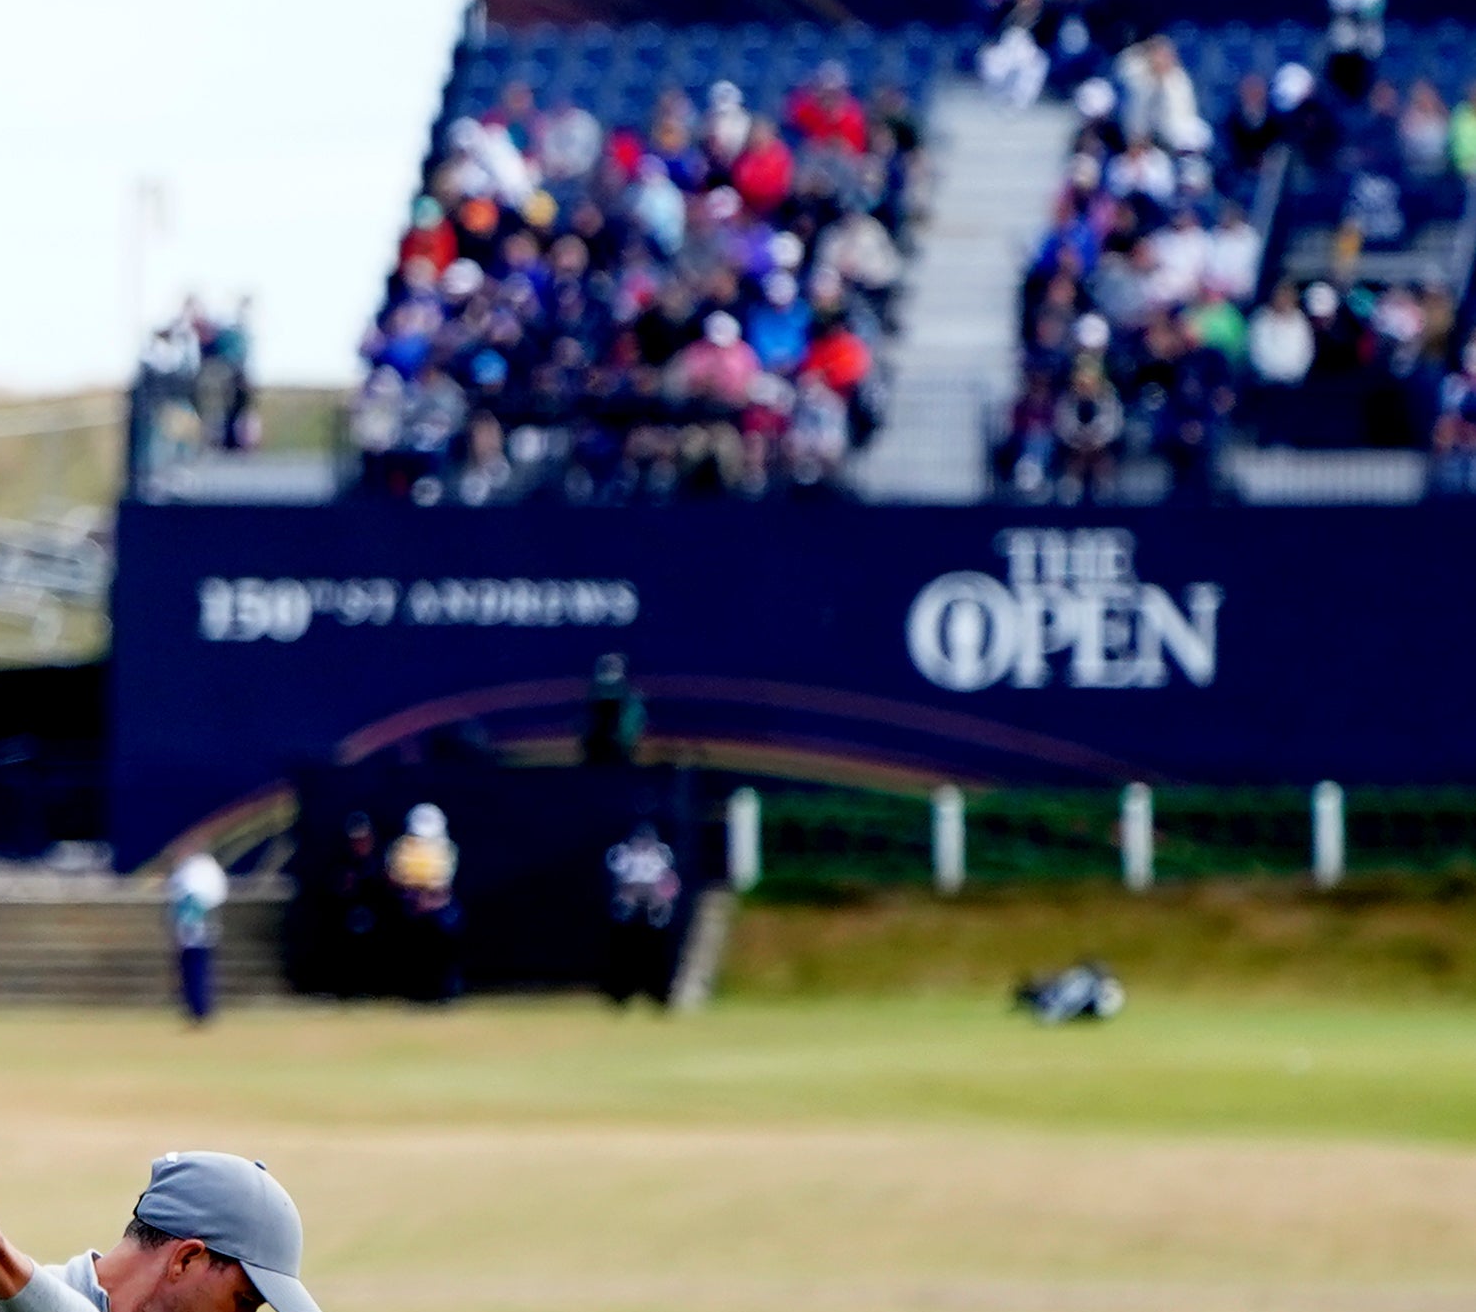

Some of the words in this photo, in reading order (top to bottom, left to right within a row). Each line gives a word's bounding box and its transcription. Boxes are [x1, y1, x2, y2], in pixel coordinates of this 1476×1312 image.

[994, 527, 1137, 587] THE
[408, 579, 638, 626] ANDREWS
[905, 570, 1225, 693] OPEN
